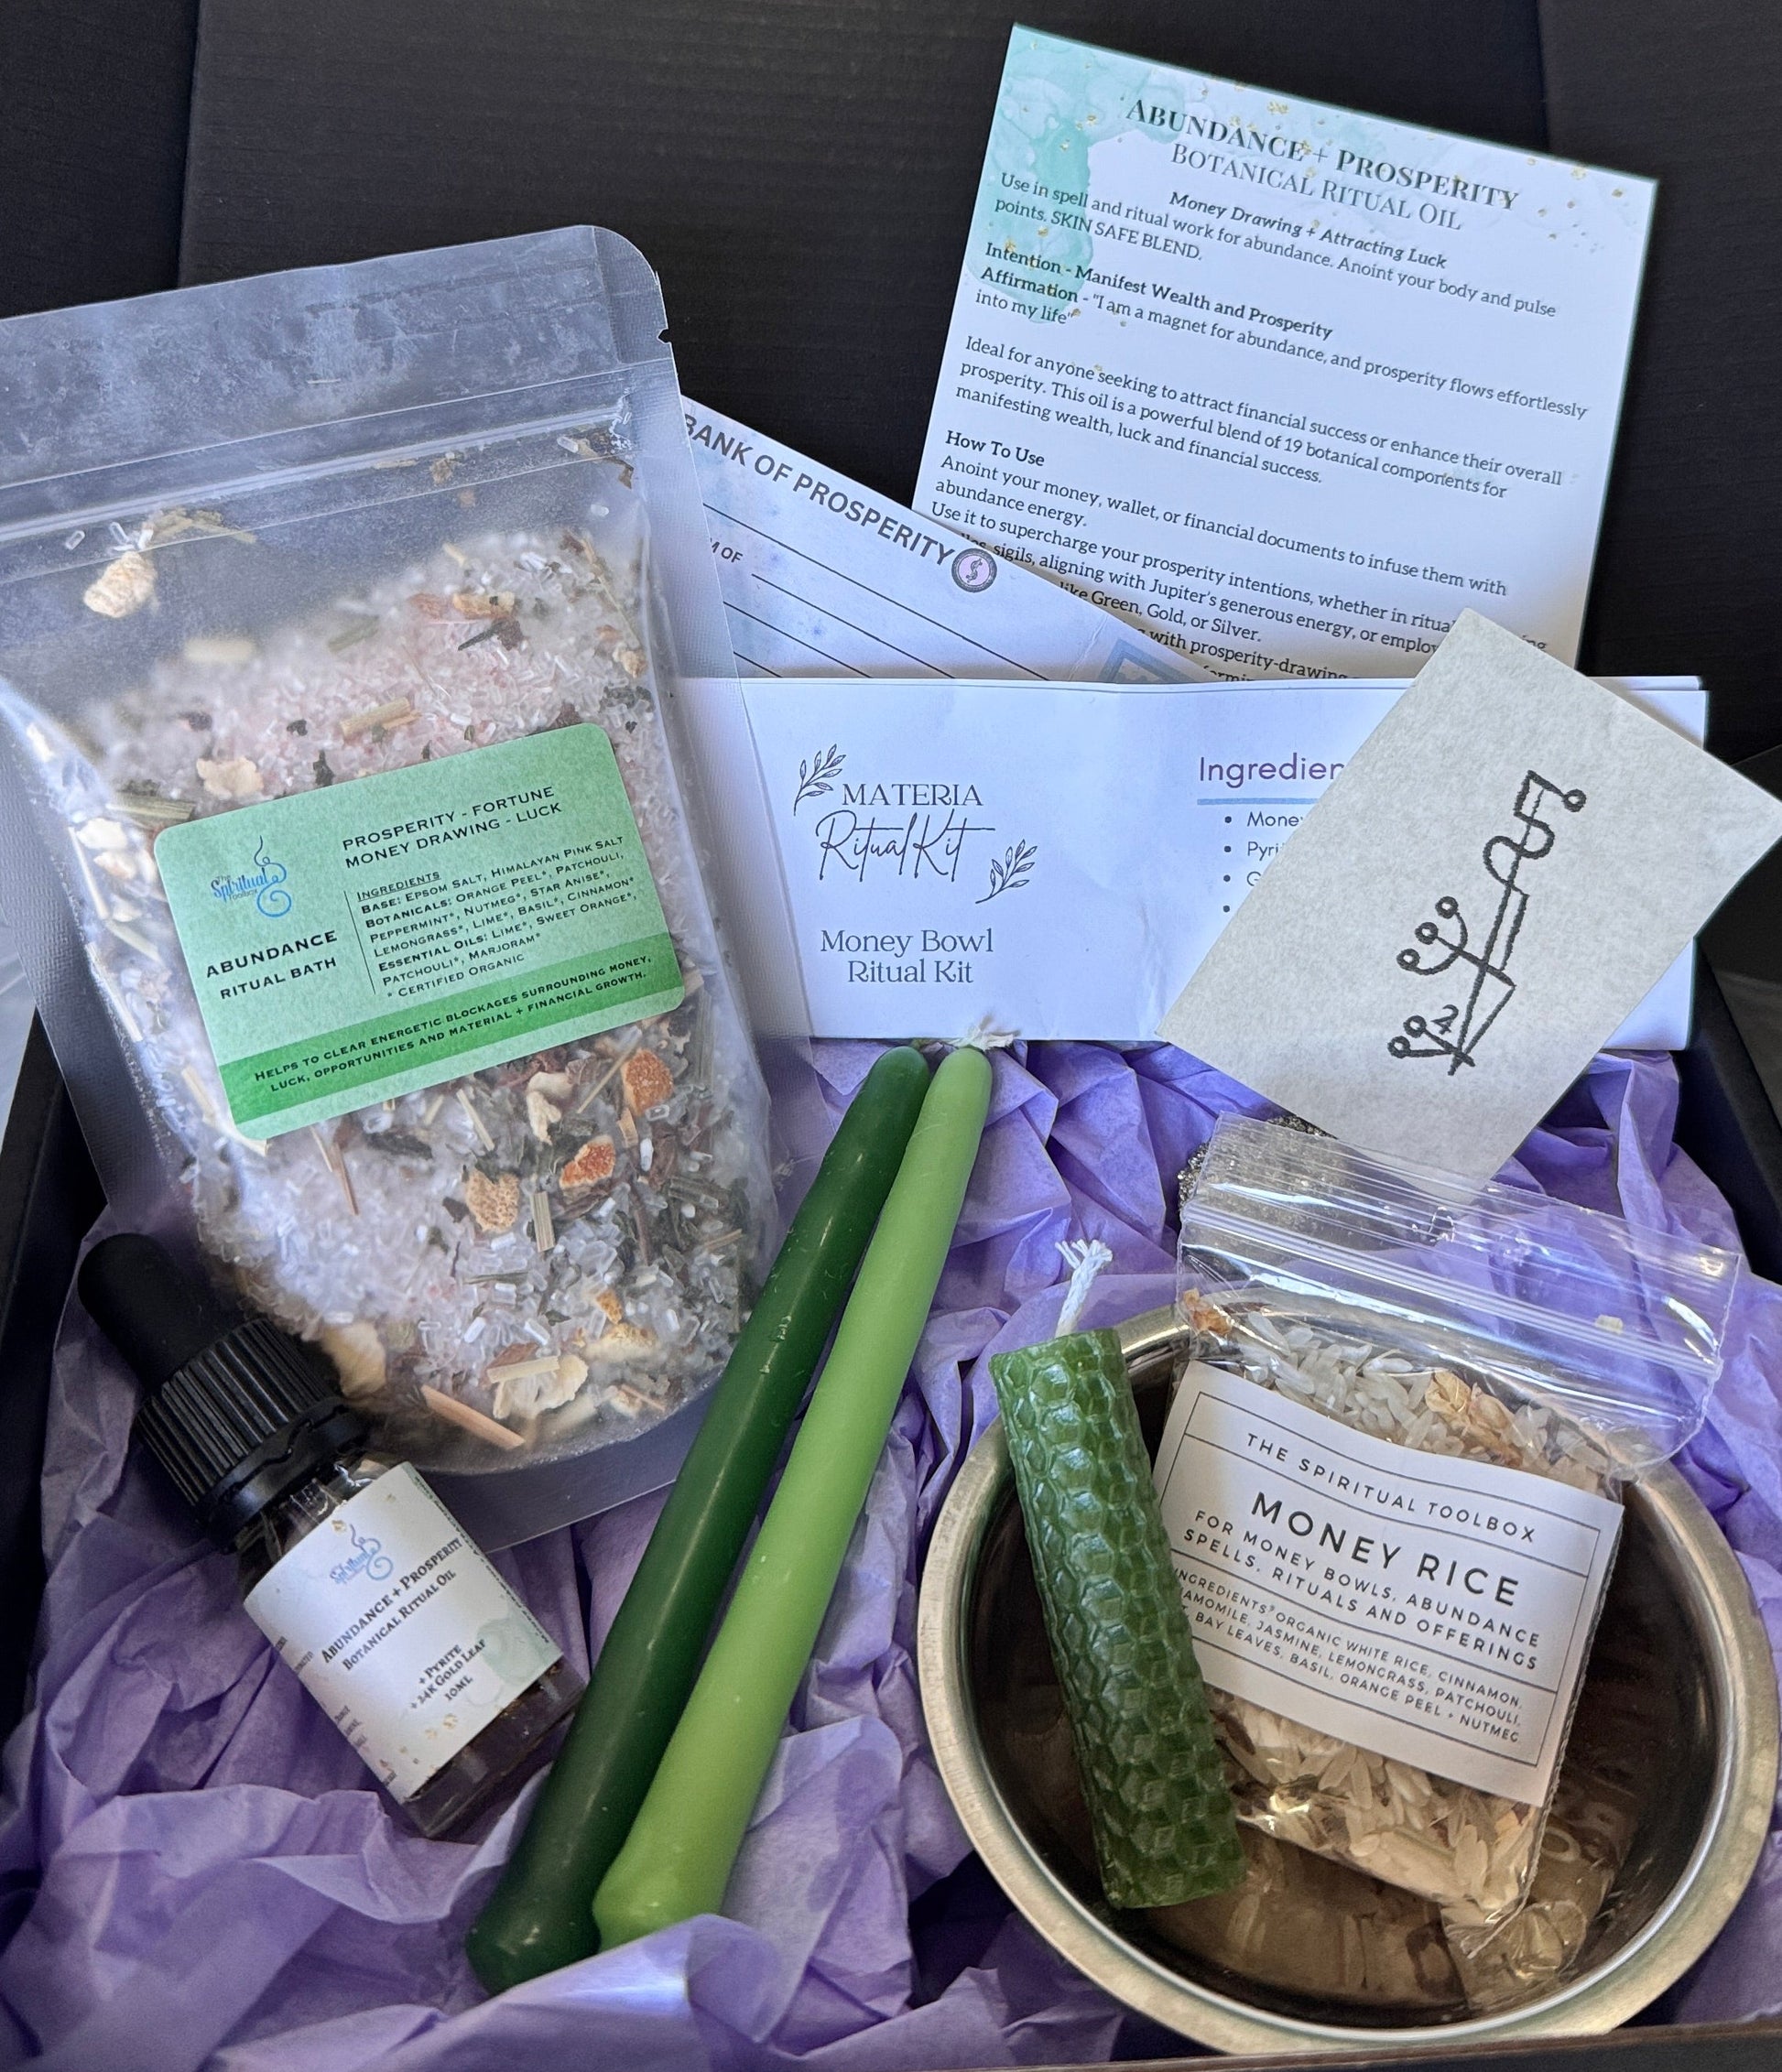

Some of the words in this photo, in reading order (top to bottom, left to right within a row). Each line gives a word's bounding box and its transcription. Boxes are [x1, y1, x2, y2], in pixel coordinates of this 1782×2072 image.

[1126, 100, 1305, 162] ABUNDANCE
[1336, 150, 1519, 210] PROSPERITY
[1171, 144, 1314, 197] BOTANICAL
[1321, 179, 1411, 219] RITUAL
[1419, 203, 1461, 231] OIL
[994, 199, 1047, 222] points.
[1050, 211, 1093, 233] SKIN
[1094, 222, 1140, 244] SAFE
[1141, 233, 1202, 261] BLEND.
[1001, 172, 1030, 193] Use
[1032, 181, 1049, 199] in
[1052, 190, 1089, 208] spell
[1091, 200, 1123, 217] and
[1125, 206, 1169, 228] ritual
[1172, 220, 1215, 240] work
[1217, 227, 1242, 245] for
[1244, 234, 1334, 268] abundance.
[1336, 257, 1395, 282] Anoint
[1397, 273, 1437, 290] your
[1439, 278, 1479, 302] body
[1481, 292, 1512, 309] and
[1514, 299, 1556, 318] pulse
[1169, 191, 1228, 220] Money
[1230, 207, 1303, 238] Drawing
[1319, 229, 1405, 262] Attracting
[1407, 248, 1448, 269] Luck
[975, 289, 1008, 309] into
[1011, 301, 1039, 320] my
[985, 242, 1061, 275] Intention
[1074, 265, 1147, 296] Manifest
[1152, 284, 1211, 311] Wealth
[1213, 303, 1246, 320] and
[1247, 308, 1333, 342] Prosperity
[965, 335, 1005, 359] Ideal
[1007, 347, 1033, 365] for
[1034, 357, 1098, 381] anyone
[1097, 373, 1158, 398] seeking
[1161, 385, 1178, 400] to
[1179, 392, 1234, 414] attract
[1235, 402, 1307, 431] financial
[1309, 422, 1367, 444] success
[1370, 436, 1389, 449] or
[1390, 440, 1460, 464] enhance
[1462, 453, 1503, 473] their
[1505, 465, 1562, 486] overall
[945, 430, 987, 452] How
[991, 440, 1012, 459] To
[1016, 447, 1045, 467] Use
[684, 413, 754, 467] BANK
[755, 454, 794, 483] OF
[793, 472, 956, 566] PROSPERITY
[721, 547, 744, 563] OF
[940, 455, 999, 481] Anoint
[1003, 472, 1041, 491] your
[1043, 483, 1103, 508] money,
[1107, 497, 1159, 521] wallet,
[1163, 512, 1182, 525] or
[1183, 513, 1255, 542] financial
[1257, 530, 1345, 561] documents
[1349, 551, 1365, 566] to
[1367, 554, 1419, 578] infuse
[1422, 567, 1464, 588] them
[1469, 579, 1506, 596] with
[1091, 591, 1143, 617] Green,
[1146, 603, 1187, 627] Gold,
[1190, 617, 1210, 630] or
[1211, 618, 1261, 642] Silver.
[342, 811, 455, 851] PROSPERITY
[473, 786, 555, 817] FORTUNE
[842, 784, 983, 807] MATERIA
[1247, 811, 1303, 827] Mone
[345, 841, 409, 869] MONEY
[416, 819, 501, 850] DRAWING
[516, 802, 562, 823] LUCK
[1248, 841, 1285, 863] Pyri
[207, 930, 338, 979] ABUNDANCE
[820, 930, 914, 959] Money
[921, 928, 994, 953] Bowl
[848, 958, 927, 983] Ritual
[934, 960, 973, 983] Kit
[220, 974, 287, 1000] RITUAL
[290, 957, 337, 979] BATH
[255, 1062, 299, 1081] HELPS
[302, 1056, 320, 1067] TO
[323, 1041, 366, 1060] CLEAR
[370, 1018, 442, 1047] ENERGETIC
[446, 994, 518, 1023] BLOCKAGES
[521, 968, 606, 999] SURROUNDING
[609, 956, 651, 973] MONEY,
[270, 1075, 310, 1092] LUCK,
[314, 1041, 415, 1078] OPPORTUNITIES
[419, 1032, 445, 1047] AND
[449, 1012, 513, 1037] MATERIAL
[527, 987, 593, 1013] FINANCIAL
[595, 971, 647, 992] GROWTH.
[1248, 1433, 1288, 1462] THE
[1298, 1459, 1415, 1513] SPIRITUAL
[1429, 1502, 1535, 1543] TOOLBOX
[1195, 1510, 1233, 1535] FOR
[1244, 1531, 1316, 1571] MONEY
[1406, 1593, 1539, 1648] ABUNDANCE
[1251, 1492, 1402, 1570] MONEY
[1417, 1553, 1519, 1607] RICE
[1180, 1588, 1250, 1627] AMOMILE,
[1272, 1567, 1358, 1612] RITUALS
[1365, 1605, 1407, 1625] AND
[1417, 1619, 1538, 1670] OFFERINGS
[1276, 1612, 1342, 1647] ORGANIC
[1347, 1640, 1389, 1662] WHITE
[1195, 1611, 1224, 1630] BAY
[1340, 1673, 1400, 1702] ORANGE
[1405, 1695, 1442, 1719] PEEL
[1460, 1714, 1519, 1743] NUTMEG
